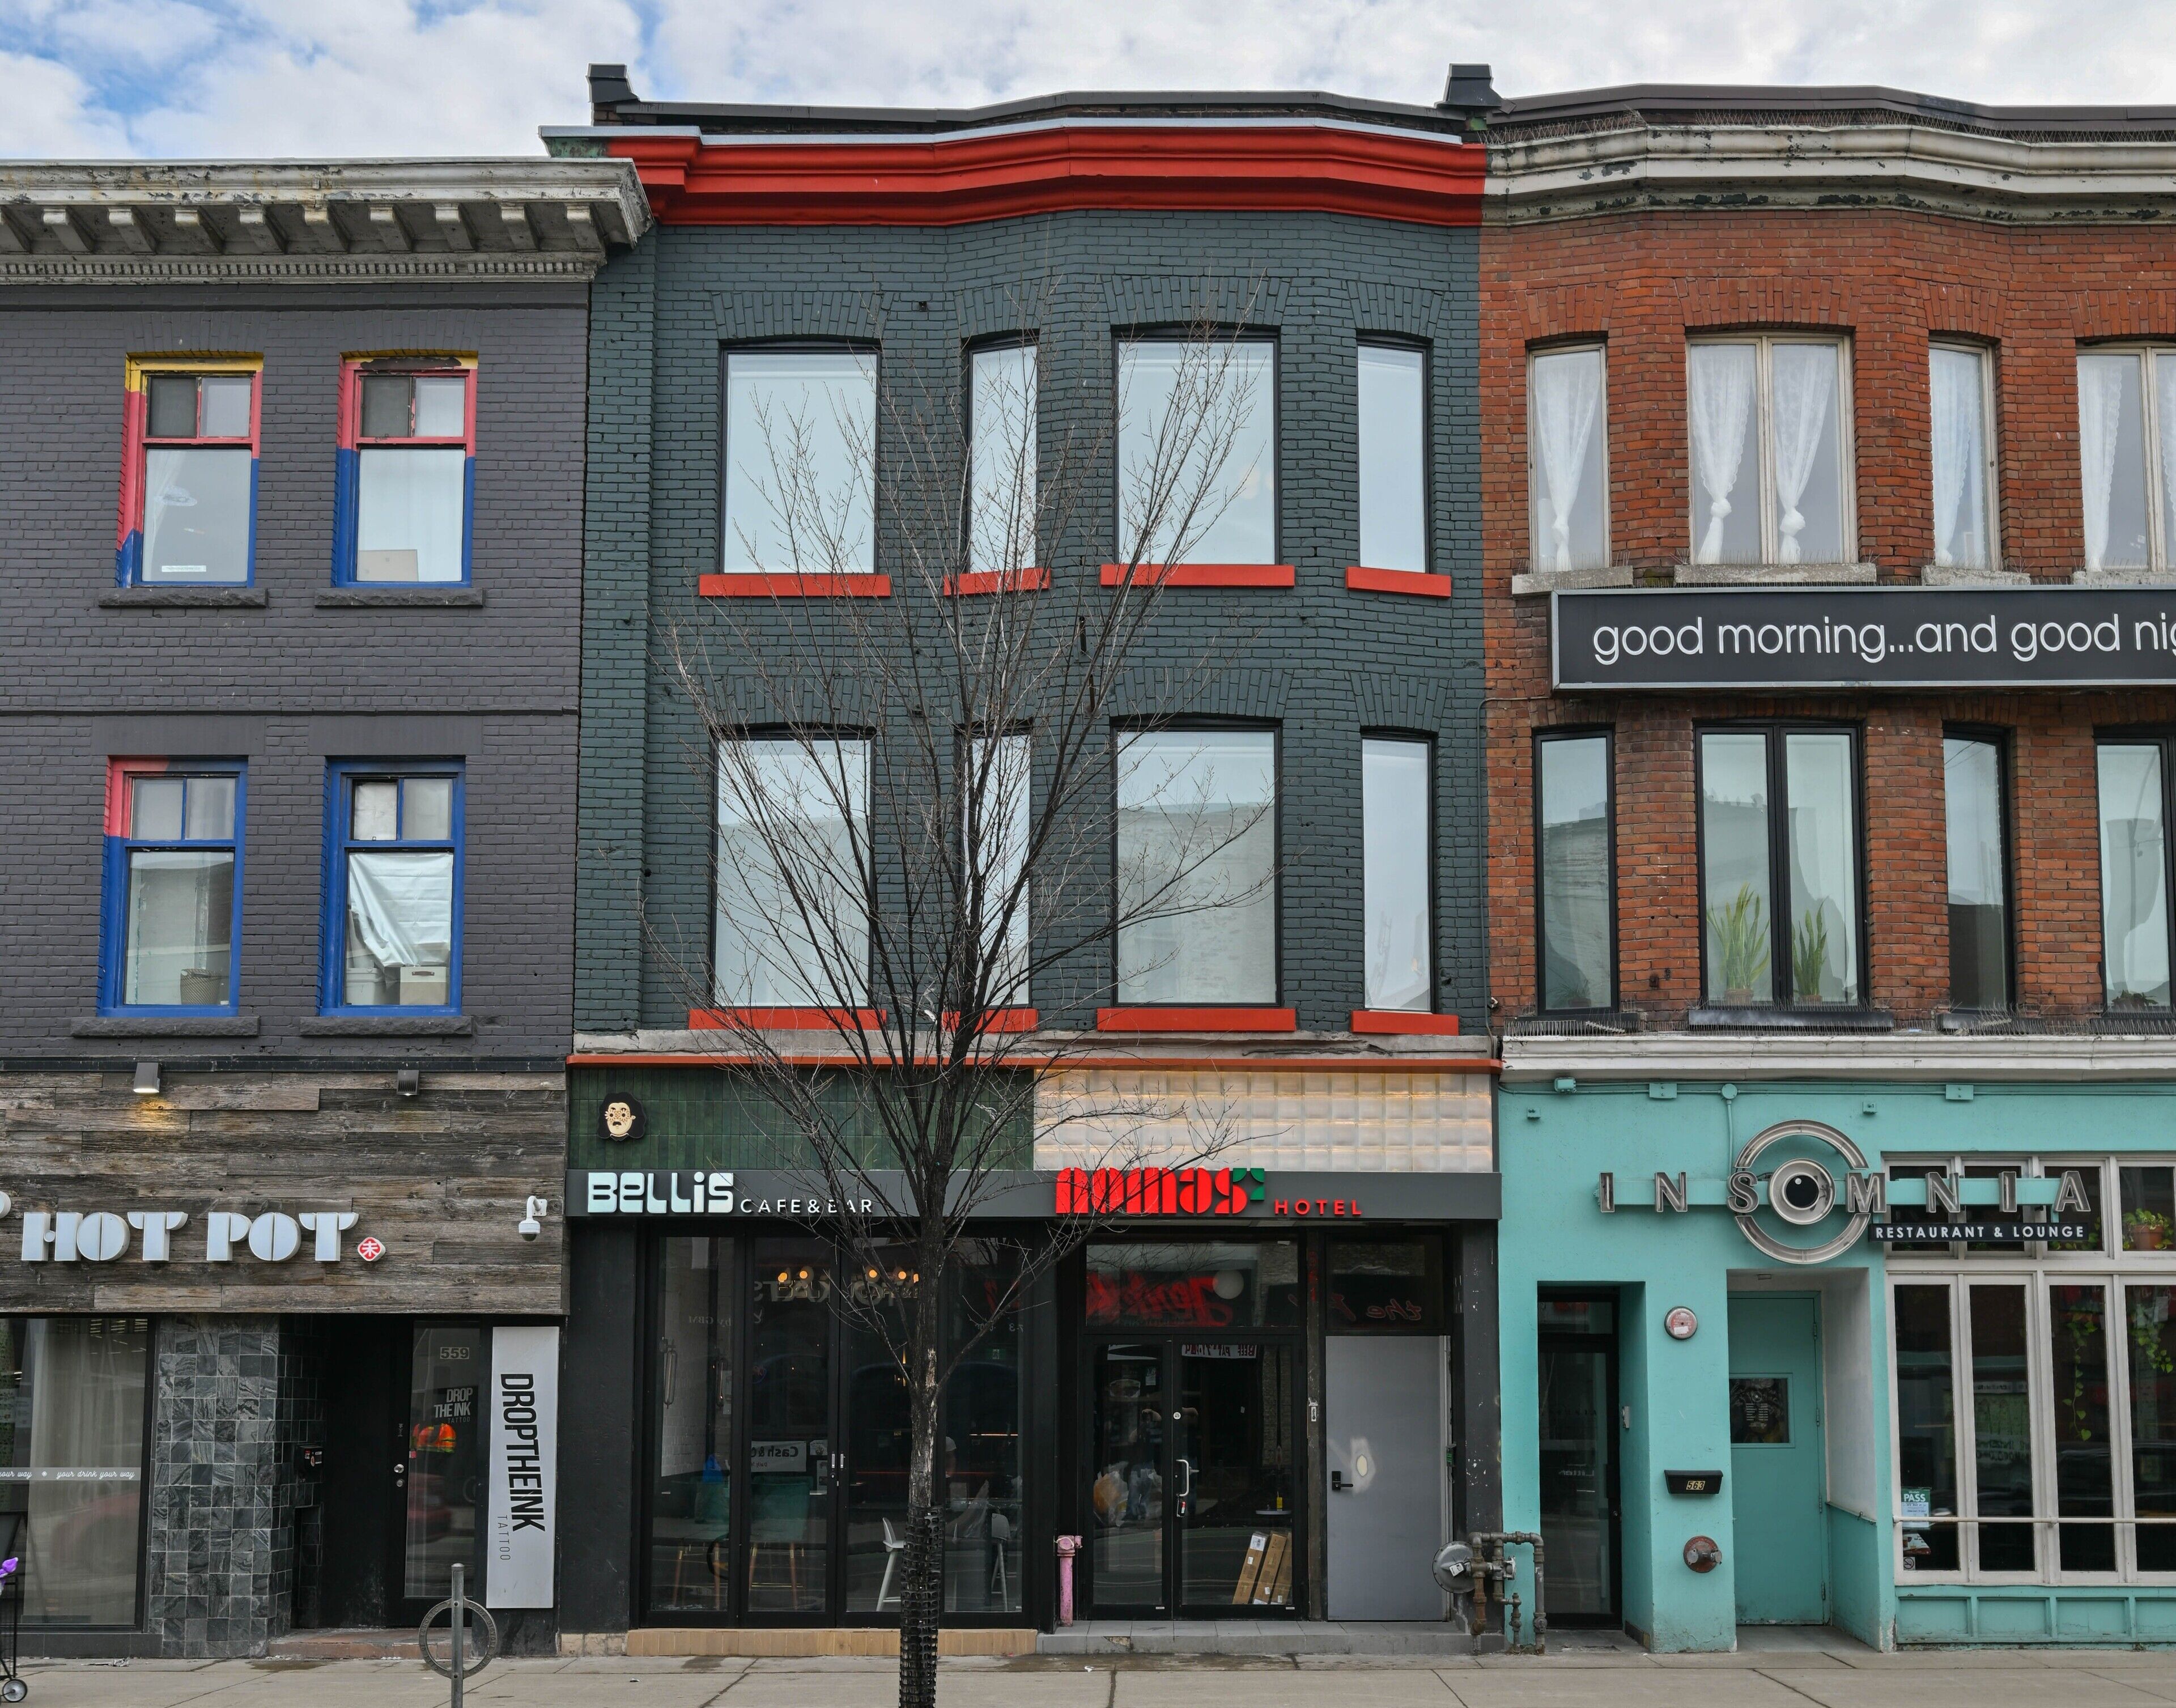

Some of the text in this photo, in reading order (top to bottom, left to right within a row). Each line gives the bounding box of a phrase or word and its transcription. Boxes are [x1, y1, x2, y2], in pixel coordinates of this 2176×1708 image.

[1593, 612, 2176, 665] good morning...and good ni
[1599, 1144, 2091, 1241] INSOMNIA
[1274, 1199, 1362, 1216] HOTEL
[21, 1212, 359, 1262] HOT POT
[1875, 1226, 2084, 1239] RESTAURANT & LOUNGE
[440, 1348, 469, 1359] 559
[446, 1387, 473, 1403] DROP
[434, 1401, 471, 1418] THE INK
[56, 1471, 75, 1480] your
[99, 1471, 117, 1480] your
[1687, 1481, 1705, 1490] 563
[1903, 1493, 1926, 1502] PASS
[497, 1514, 511, 1561] TATTOO
